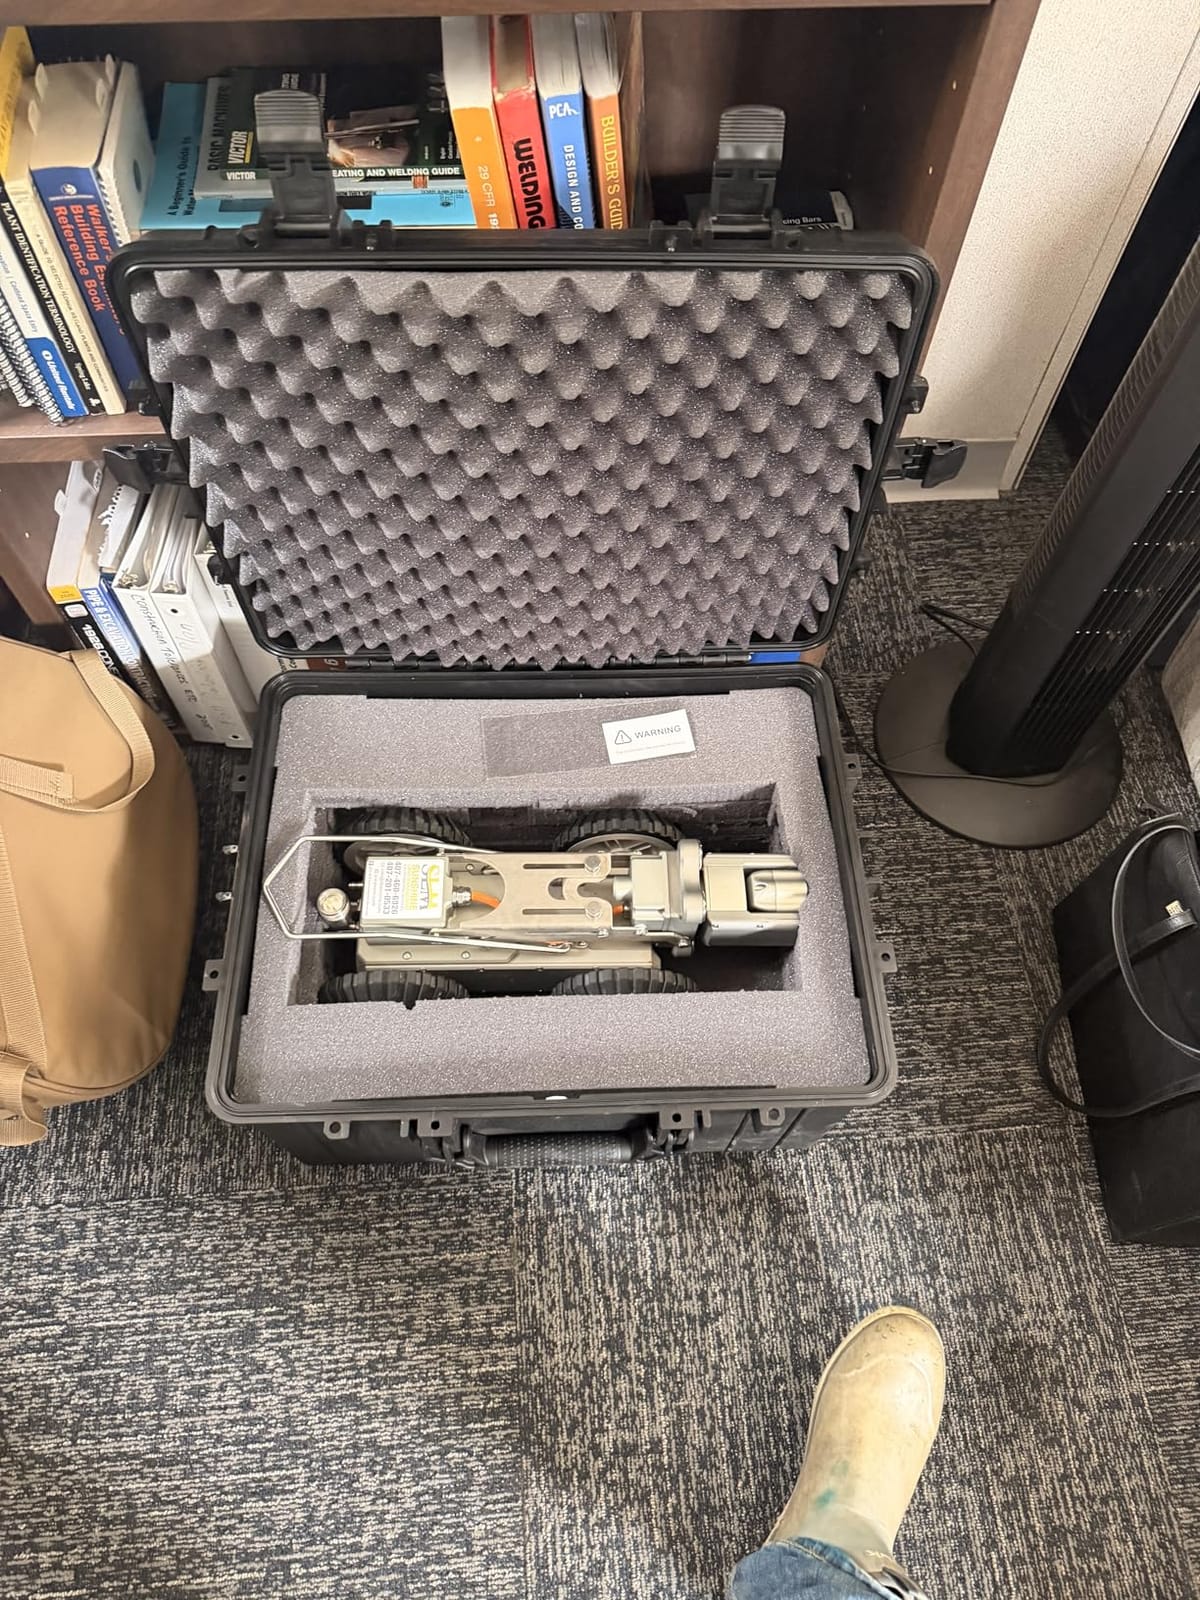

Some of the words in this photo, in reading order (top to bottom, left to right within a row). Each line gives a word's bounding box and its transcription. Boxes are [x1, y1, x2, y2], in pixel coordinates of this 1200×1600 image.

[549, 102, 579, 119] PCA
[177, 151, 191, 170] Guide
[228, 131, 247, 164] VICTOR
[601, 115, 620, 195] BUILDER'S
[226, 171, 256, 181] VICTOR
[332, 169, 364, 178] EATING
[366, 169, 386, 177] AND
[387, 168, 429, 176] WELDING
[431, 167, 460, 175] GUIDE
[478, 166, 490, 179] 29
[564, 145, 579, 187] DESIGN
[169, 172, 187, 210] Beginner's
[482, 182, 496, 207] CFR
[513, 137, 547, 229] WELDING
[569, 191, 582, 213] AND
[609, 198, 623, 230] GUID
[70, 204, 99, 262] Building
[573, 217, 584, 229] CO
[53, 205, 89, 276] Reference
[84, 279, 105, 312] Book
[1, 202, 20, 231] PLANT
[15, 229, 51, 299] IDENTIFICATION
[45, 297, 77, 354] TERMINOLOGY
[46, 358, 62, 385] United
[82, 623, 103, 650] 1926
[85, 589, 102, 611] PIPE
[94, 604, 105, 614] &
[101, 613, 131, 658] EXCAVATION
[635, 725, 681, 739] WARNING
